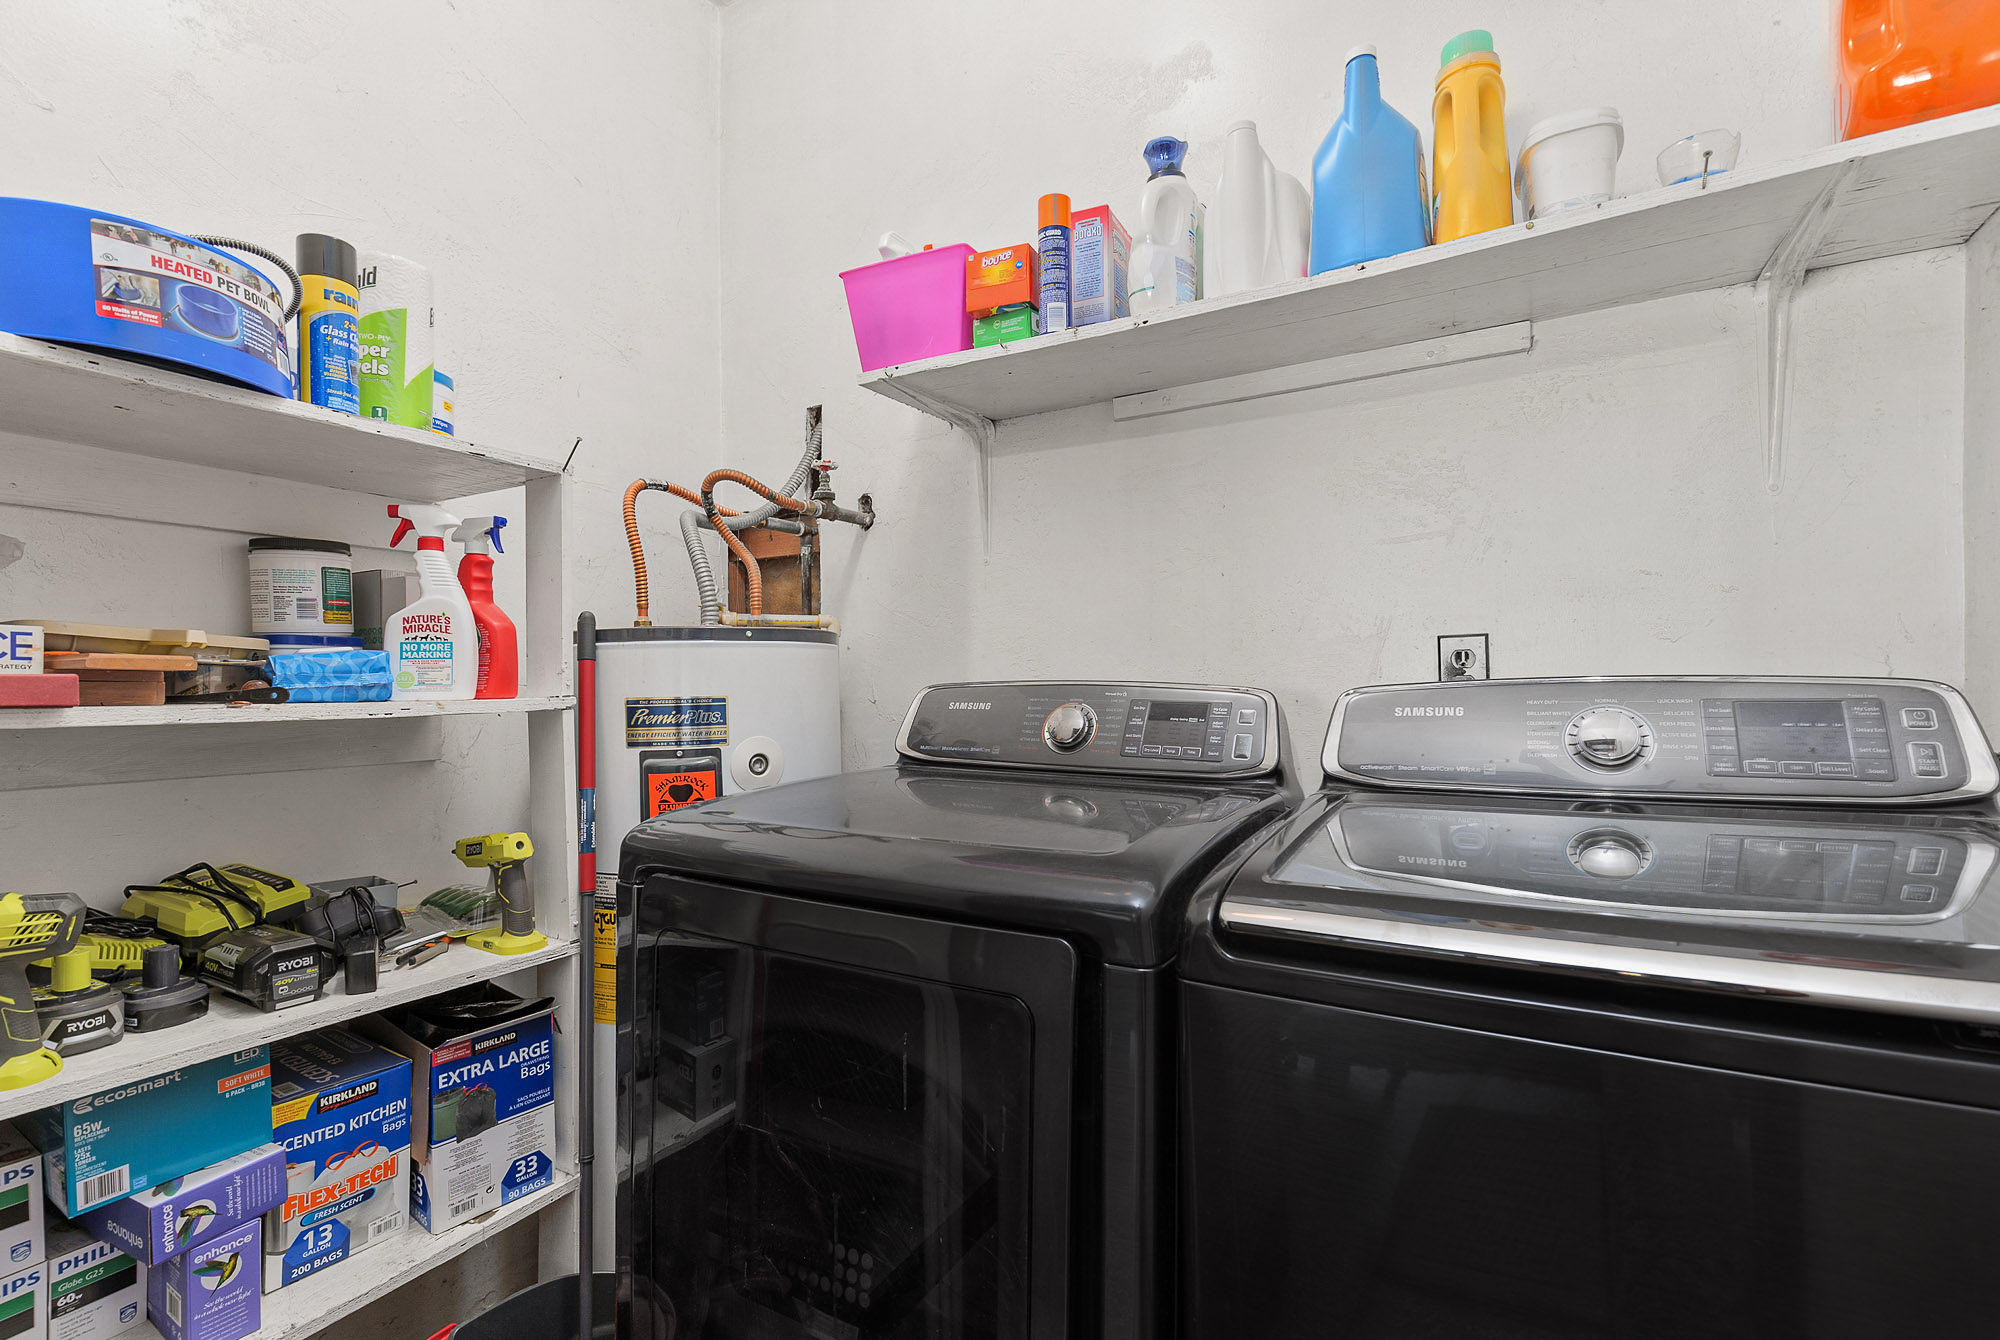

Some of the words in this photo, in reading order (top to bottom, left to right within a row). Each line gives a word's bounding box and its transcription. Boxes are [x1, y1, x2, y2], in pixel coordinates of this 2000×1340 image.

[982, 250, 1014, 268] bounce
[150, 254, 213, 285] HEATED
[217, 275, 241, 296] PET
[244, 286, 271, 314] BOWL
[320, 325, 348, 339] Glass
[332, 338, 349, 348] Rain
[358, 344, 391, 360] per
[359, 359, 389, 376] els
[402, 612, 451, 626] NATURE'S
[402, 623, 453, 635] MIRACLE
[402, 643, 418, 651] NO
[420, 643, 451, 651] MORE
[402, 651, 451, 659] MARKING
[948, 702, 992, 710] SAMSUNG
[1394, 706, 1465, 717] SAMSUNG
[655, 775, 709, 793] SHAMROCK
[466, 845, 482, 855] RYOBI
[277, 956, 314, 972] RYOBI
[274, 977, 295, 986] 40V
[66, 1015, 106, 1033] RYOBI
[474, 1032, 517, 1051] KIRKLAND
[233, 1047, 259, 1063] LED
[438, 1059, 495, 1090] EXTRA
[498, 1039, 550, 1069] LARGE
[520, 1061, 551, 1079] Bags
[225, 1076, 242, 1088] SOFT
[243, 1069, 265, 1082] WHITE
[94, 1071, 182, 1107] ecosmart
[230, 1087, 245, 1097] PACK
[320, 1081, 378, 1108] KIRKLAND
[349, 1098, 407, 1132] KITCHEN
[74, 1127, 110, 1143] REPLACEMENT
[382, 1118, 407, 1134] Bags
[74, 1145, 92, 1155] LASTS
[515, 1155, 538, 1178] 33
[516, 1170, 538, 1183] GALLON
[281, 1153, 399, 1224] FLEX-TECH
[508, 1189, 519, 1200] 90
[521, 1177, 546, 1194] BAGS
[313, 1204, 339, 1221] FRESH
[339, 1194, 365, 1211] SCENT
[107, 1220, 144, 1249] enhance
[162, 1204, 175, 1253] enhance
[303, 1223, 333, 1250] 13
[194, 1233, 254, 1264] enhance
[302, 1242, 331, 1258] GALLON
[291, 1263, 311, 1278] 200
[313, 1249, 343, 1268] BAGS
[0, 1270, 41, 1297] IPS
[58, 1278, 83, 1292] Globe
[85, 1267, 105, 1281] G25
